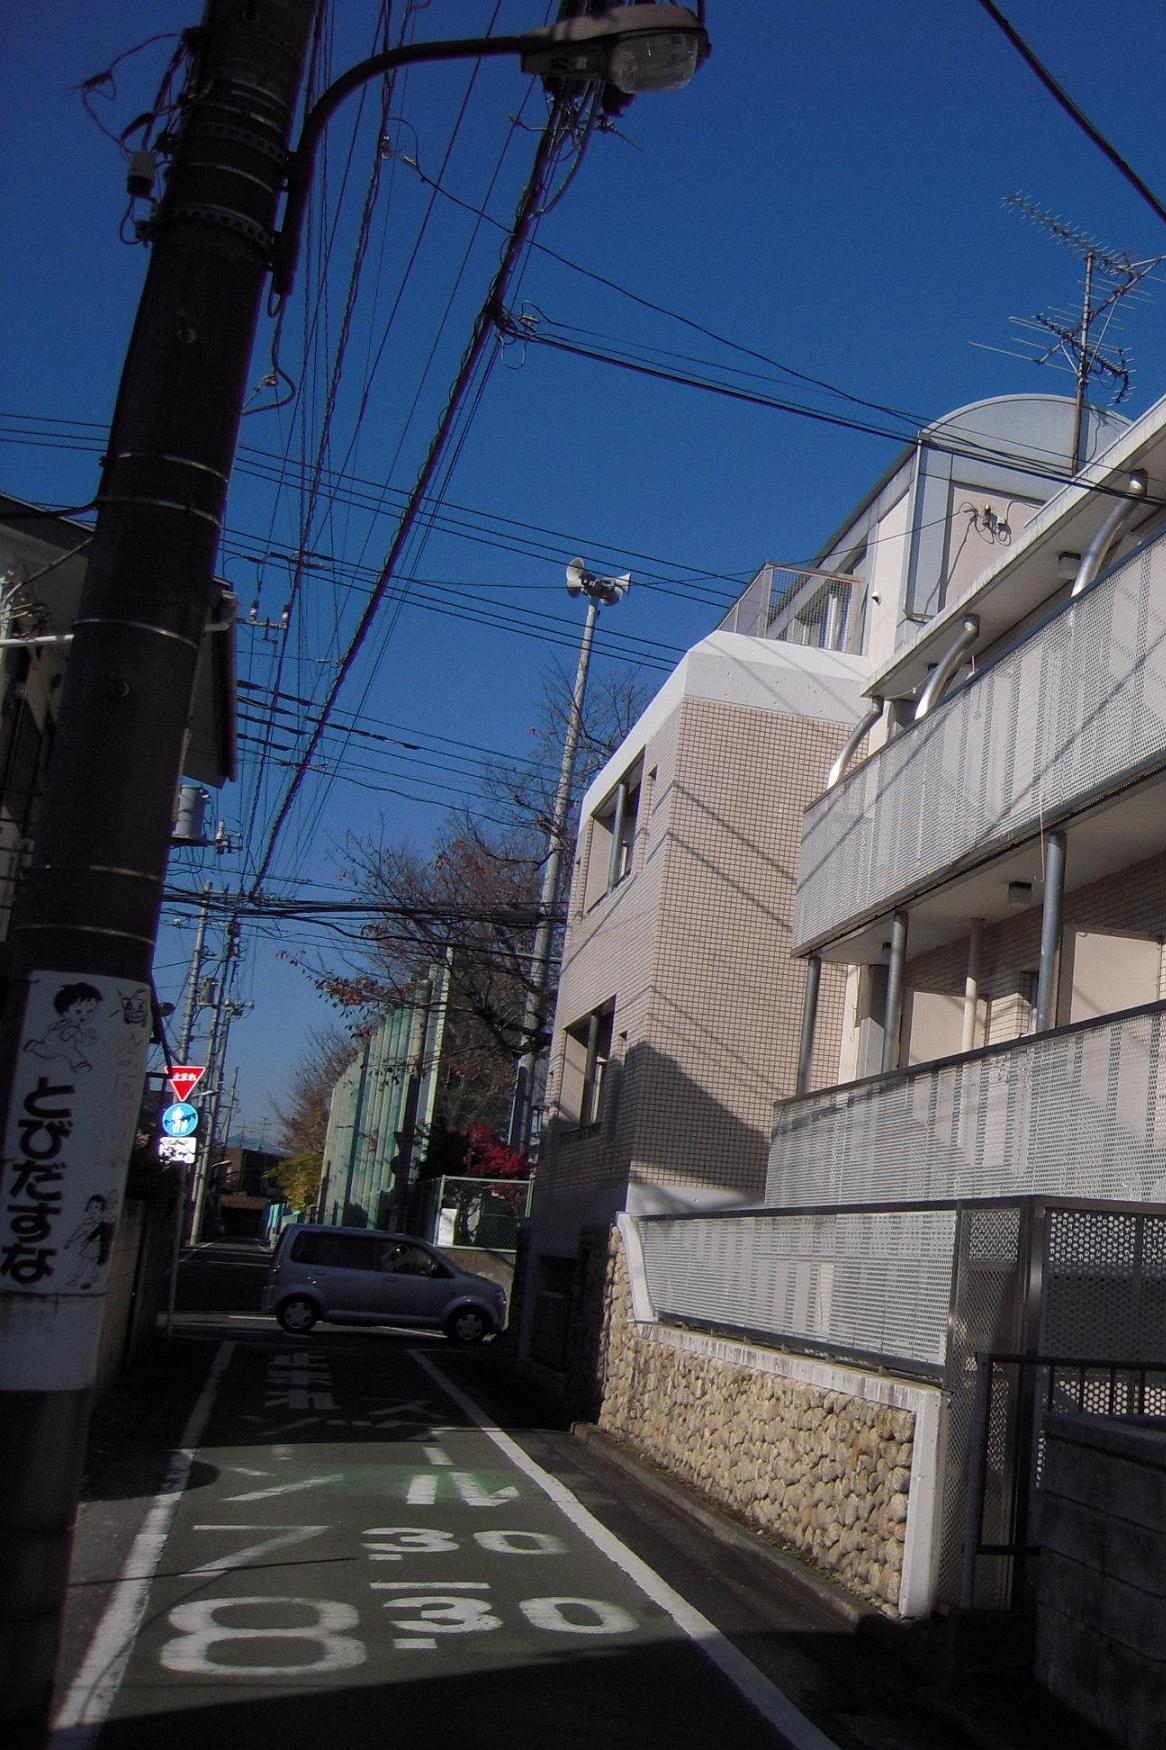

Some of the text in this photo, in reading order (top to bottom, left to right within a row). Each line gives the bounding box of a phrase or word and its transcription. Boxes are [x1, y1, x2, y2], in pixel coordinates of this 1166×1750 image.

[173, 1073, 197, 1081] 止まれ
[0, 1077, 75, 1284] とびだすな
